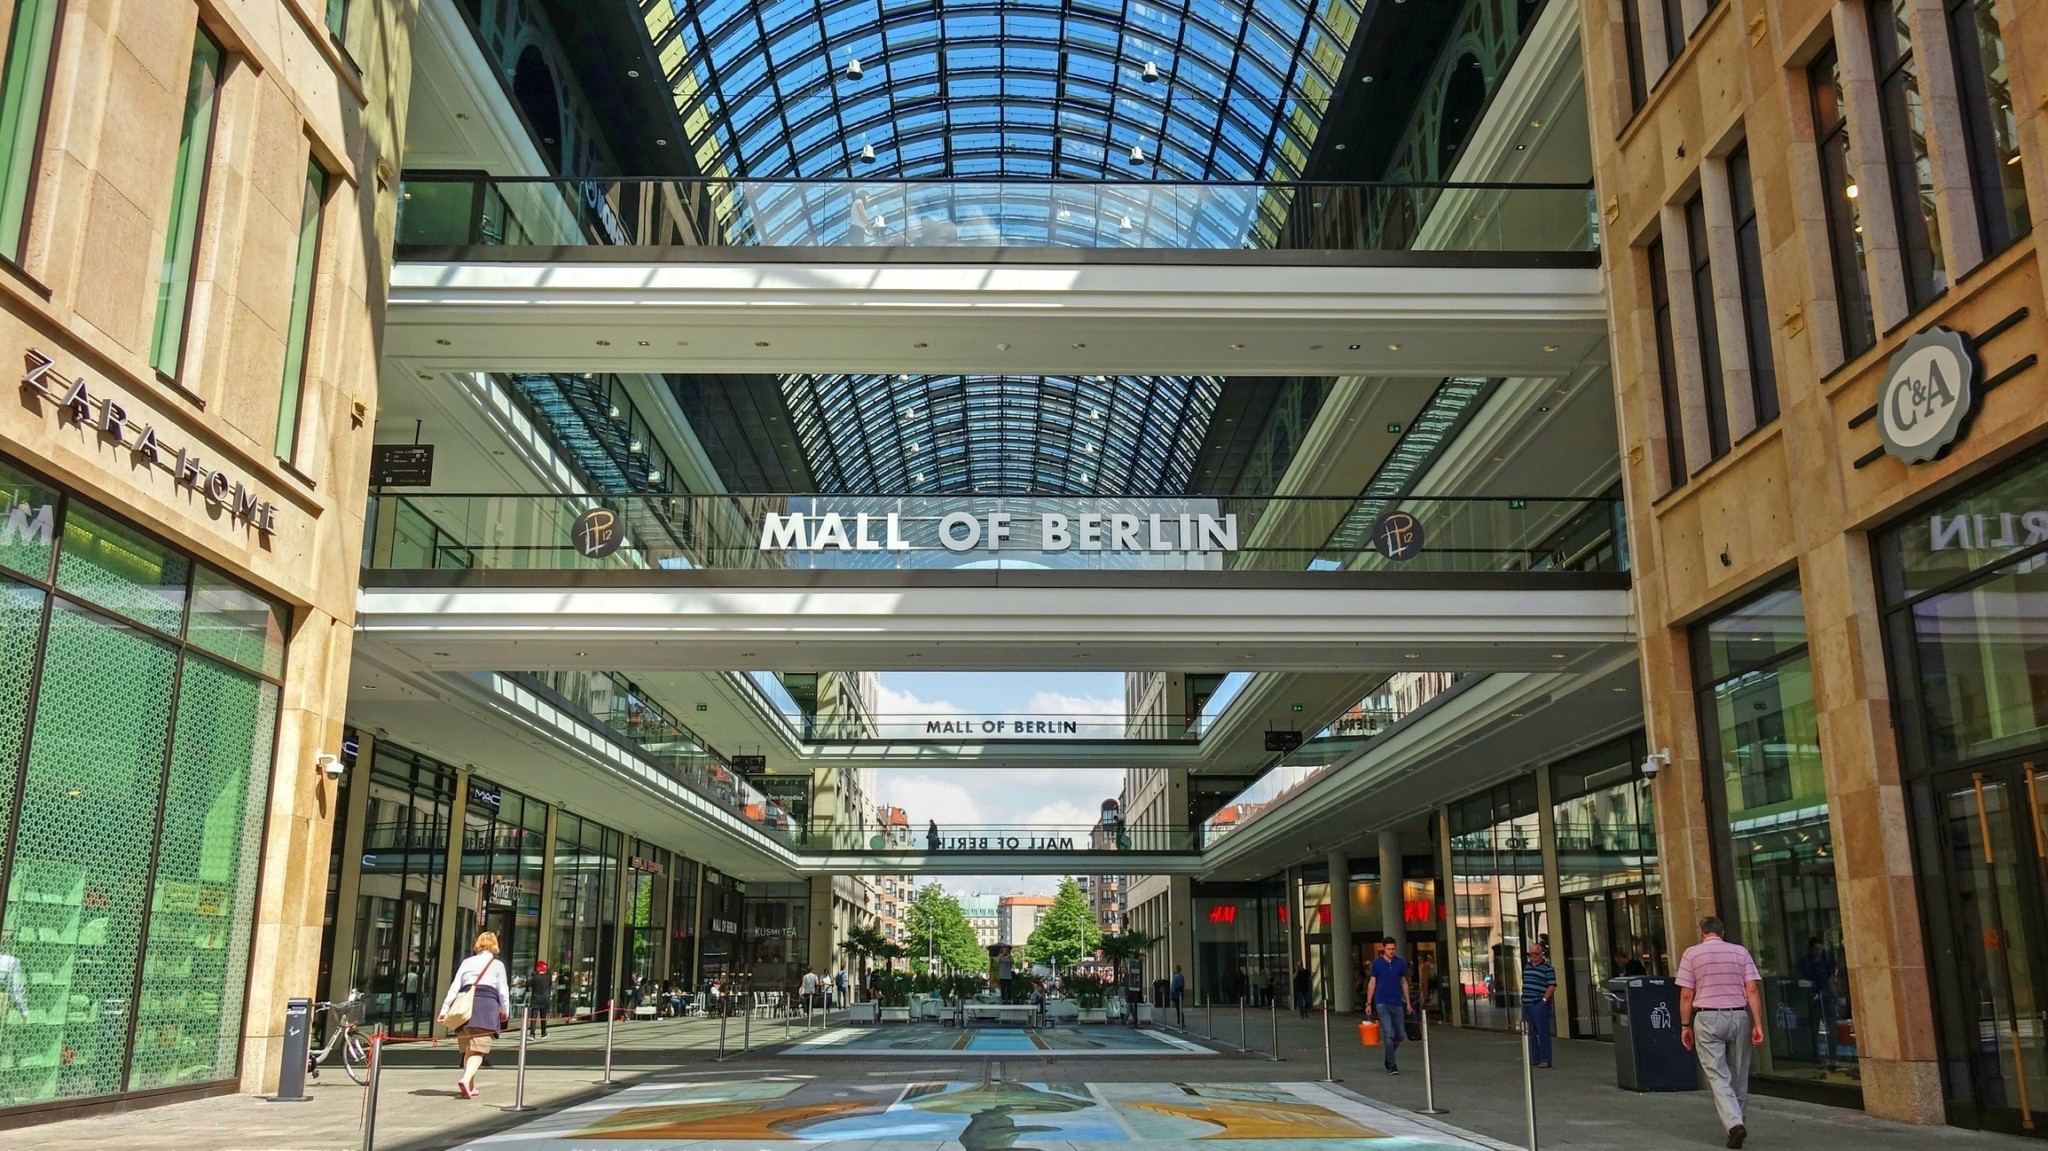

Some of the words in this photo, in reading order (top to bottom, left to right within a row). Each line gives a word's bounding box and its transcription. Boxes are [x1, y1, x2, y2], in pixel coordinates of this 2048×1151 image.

[1892, 359, 1955, 431] C&A
[21, 348, 160, 463] ZARA
[175, 446, 279, 536] HOME
[759, 512, 910, 551] MALL
[938, 511, 1011, 551] OF
[1042, 513, 1238, 552] BERLIN
[926, 720, 973, 734] MALL
[982, 720, 1005, 734] OF
[1014, 720, 1077, 734] BERLIN
[474, 788, 501, 806] MAC
[1208, 905, 1236, 924] H&M
[755, 926, 780, 938] KUSMI
[781, 926, 797, 938] TEA
